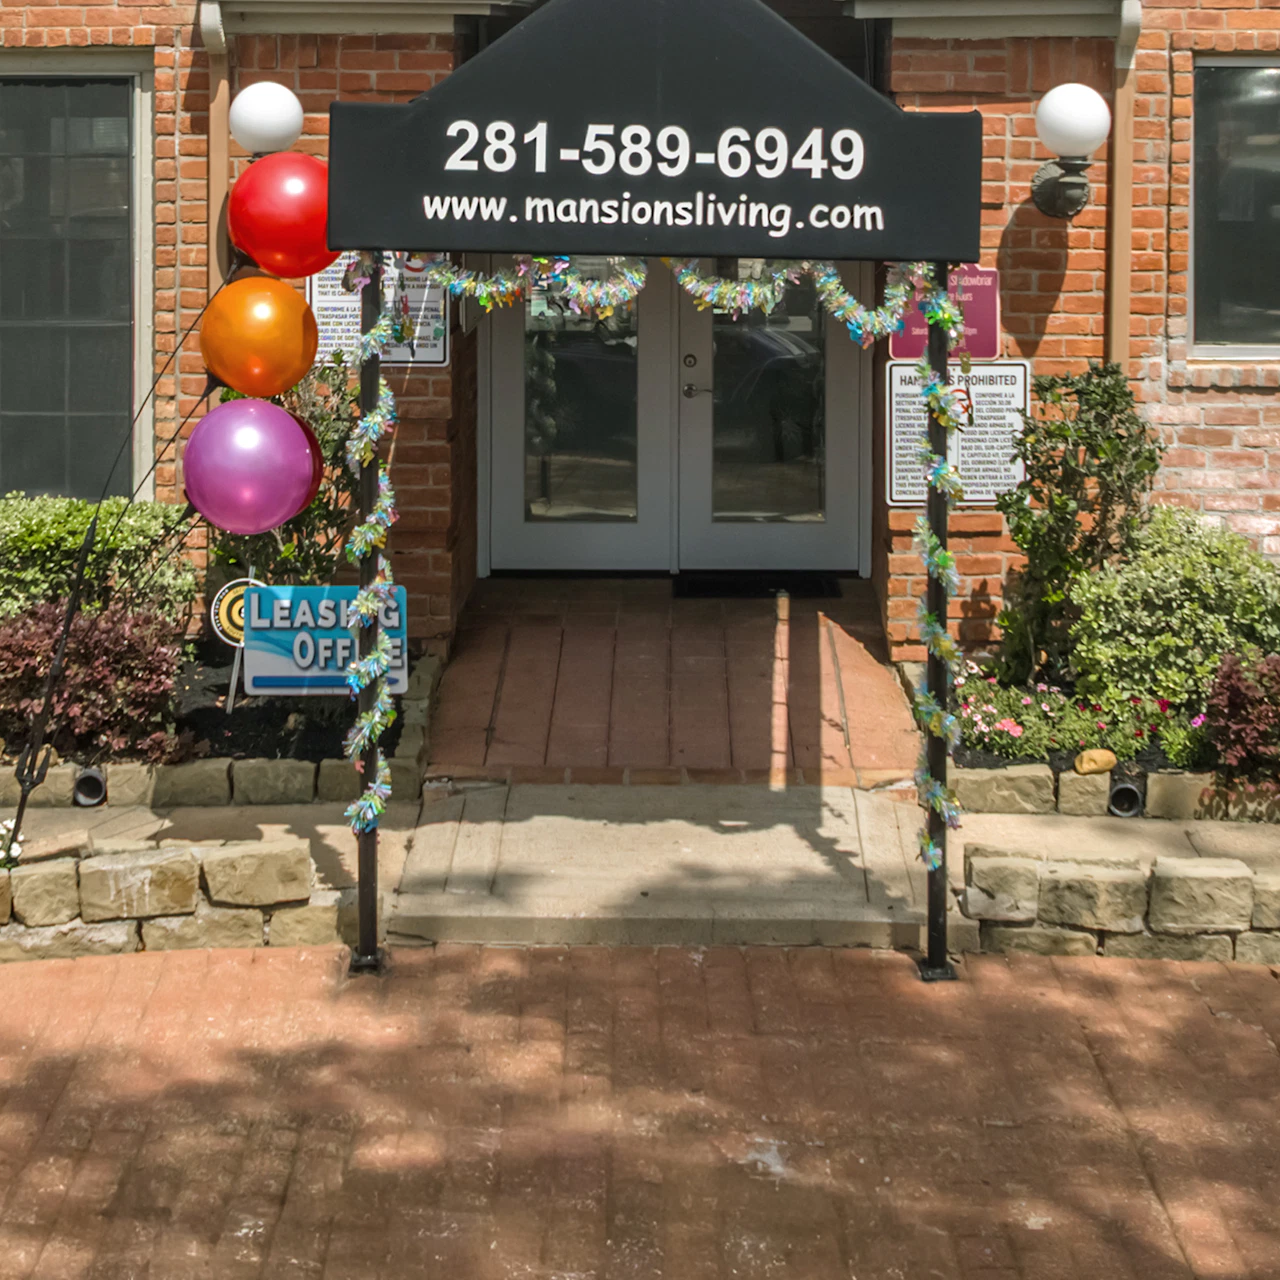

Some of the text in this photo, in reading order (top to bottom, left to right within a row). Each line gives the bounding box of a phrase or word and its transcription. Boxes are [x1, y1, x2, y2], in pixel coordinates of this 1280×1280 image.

[444, 119, 865, 181] 281-589-6949
[423, 191, 884, 238] www.mansionsliving.com
[958, 375, 1017, 386] PROHIBITED
[250, 593, 400, 628] LEASIG
[292, 631, 403, 669] OFFIE
